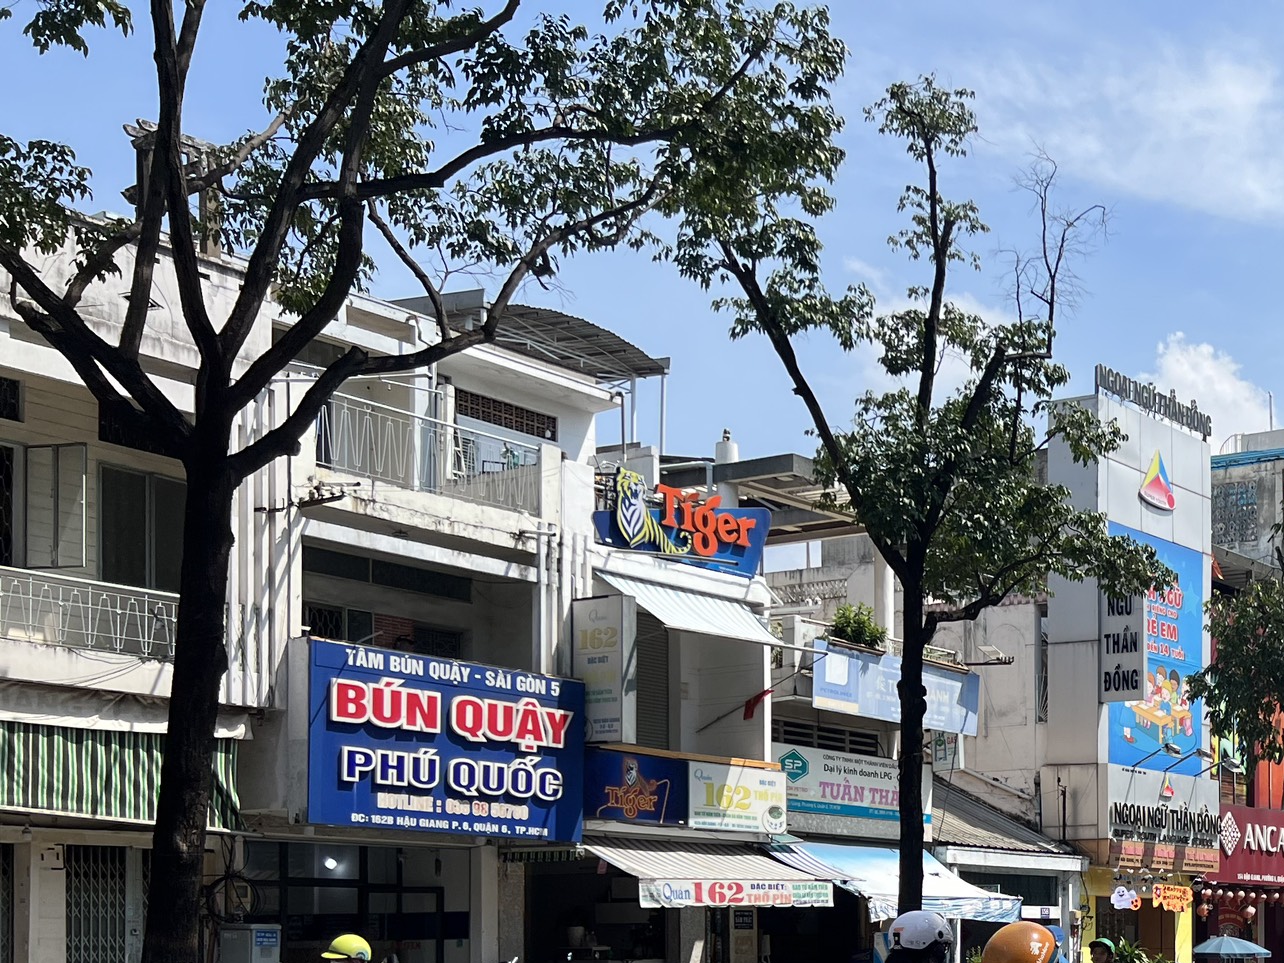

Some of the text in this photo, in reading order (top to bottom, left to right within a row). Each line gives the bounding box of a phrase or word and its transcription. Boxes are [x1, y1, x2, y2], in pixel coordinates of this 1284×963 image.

[655, 483, 756, 556] Tiger
[579, 627, 618, 650] 162
[1104, 625, 1138, 654] THẦN
[1160, 620, 1178, 642] EM
[1159, 644, 1170, 657] 14
[346, 645, 384, 670] TÂM
[390, 648, 424, 676] BÚN
[429, 660, 471, 685] QUẬY
[485, 668, 511, 689] SÀI
[516, 670, 546, 694] GÒN
[550, 682, 561, 696] 5
[1103, 663, 1139, 692] ĐỒNG
[331, 677, 574, 753] BÚN QUẬY
[341, 746, 563, 801] PHÚ QUỐC
[784, 759, 803, 770] SP
[836, 765, 843, 775] lý
[843, 766, 858, 776] kinh
[858, 768, 879, 779] doanh
[879, 771, 893, 781] LPG
[604, 784, 658, 819] Tiger
[703, 782, 752, 811] 162
[818, 776, 866, 803] TUẤN
[377, 792, 434, 813] HOTLINE
[436, 799, 442, 814] :
[472, 800, 489, 817] 98
[1114, 801, 1223, 836] NGOẠI NGỮ THẦN ĐỒNG
[351, 813, 369, 824] ĐC:
[371, 814, 394, 826] 162B
[396, 815, 417, 828] HẬU
[419, 818, 449, 830] GIANG
[473, 821, 499, 834] QUẬN
[515, 826, 548, 837] TP.HCM
[662, 882, 691, 902] Quán
[691, 881, 745, 905] 162
